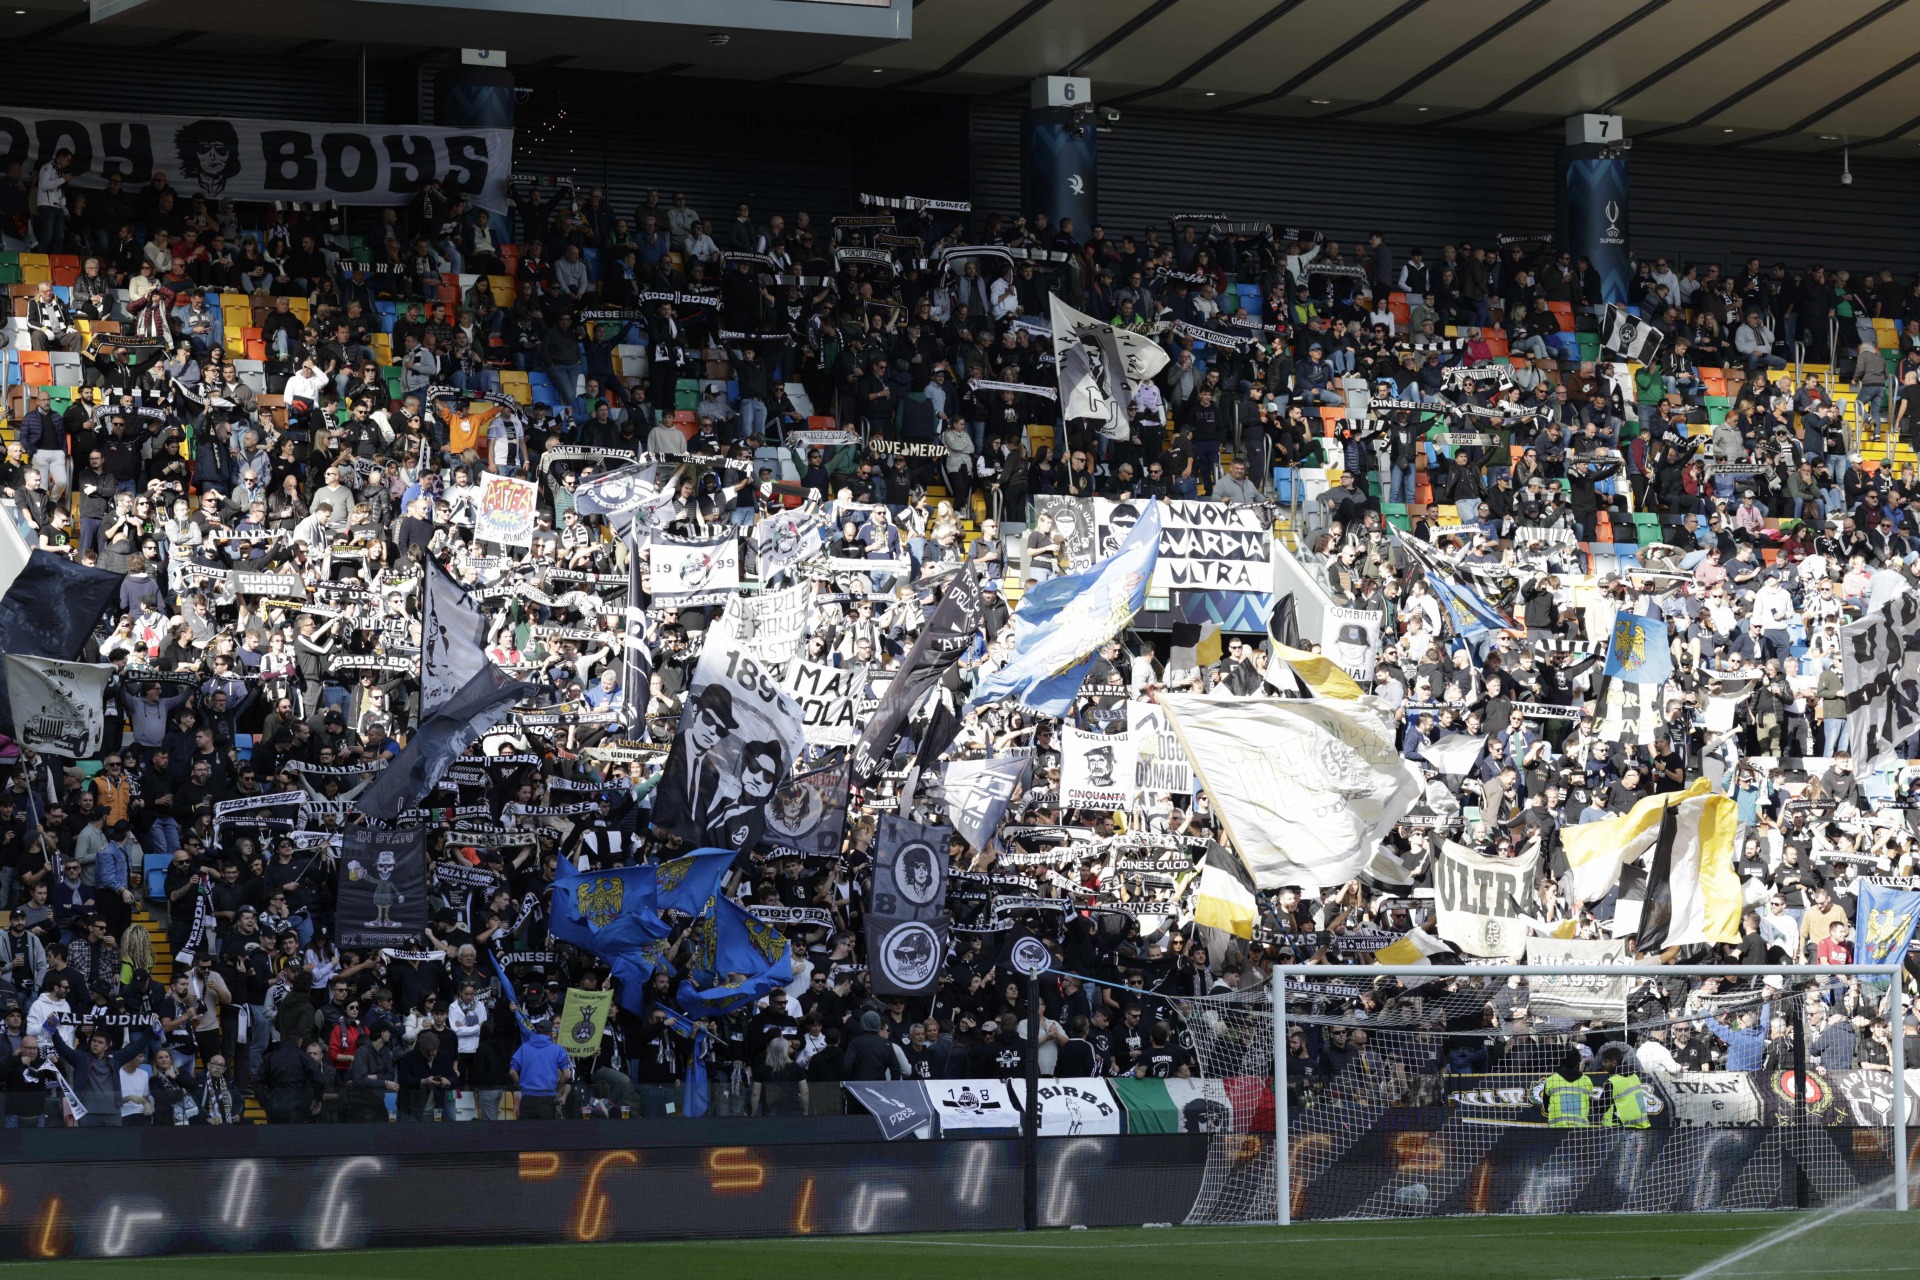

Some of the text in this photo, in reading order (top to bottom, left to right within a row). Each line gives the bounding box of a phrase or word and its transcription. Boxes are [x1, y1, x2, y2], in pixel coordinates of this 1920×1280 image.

[1063, 82, 1076, 101] 6
[1599, 121, 1609, 137] 7
[260, 130, 489, 195] BOYS
[844, 249, 886, 261] FORZA UDINESE
[681, 294, 718, 307] BOYS
[1231, 318, 1277, 332] Udinese nel
[1207, 331, 1237, 347] UDINESE
[1471, 405, 1537, 417] UDINESE CALCIO
[870, 439, 950, 457] JUVE MERDA
[683, 457, 705, 465] ULTRA
[1715, 464, 1767, 473] UDINESE
[486, 480, 534, 516] ATTA
[1046, 498, 1094, 540] GUARDIA ULTRA
[1168, 503, 1245, 527] NUOVA
[186, 565, 224, 576] TEDDY
[656, 559, 736, 573] 19 99
[238, 574, 295, 585] CURVA
[1169, 561, 1252, 586] ULTRA
[244, 584, 290, 595] NORD
[1330, 607, 1379, 621] COMBINA
[535, 627, 600, 639] UDINESE
[58, 668, 75, 680] NORD
[128, 670, 197, 681] UDINESE
[793, 664, 854, 697] MAI
[1075, 731, 1110, 742] QUELLI
[617, 739, 658, 750] UDINESE
[304, 760, 374, 774] UDINESE
[449, 771, 479, 781] UDINESE
[1136, 765, 1188, 791] DOMANI
[570, 777, 623, 791] UDINESE
[1068, 789, 1126, 801] CINQUANTA
[219, 801, 246, 813] FORZA
[525, 802, 591, 814] UDINESE
[1067, 799, 1126, 811] SESSANTA
[1156, 860, 1189, 870] CALCIO
[992, 873, 1038, 890] BOYS
[1437, 850, 1536, 919] ULTRA
[1109, 903, 1170, 914] UDINESE
[185, 895, 204, 948] TEDDY
[1252, 929, 1318, 946] ULTRAS
[1357, 939, 1391, 949] udinese
[917, 966, 929, 978] BB
[1562, 974, 1609, 988] 1995
[61, 1013, 150, 1026] ALE' UDIN
[1152, 1055, 1173, 1063] UDINE
[1672, 1080, 1738, 1095] IVAN
[948, 1089, 955, 1100] 1
